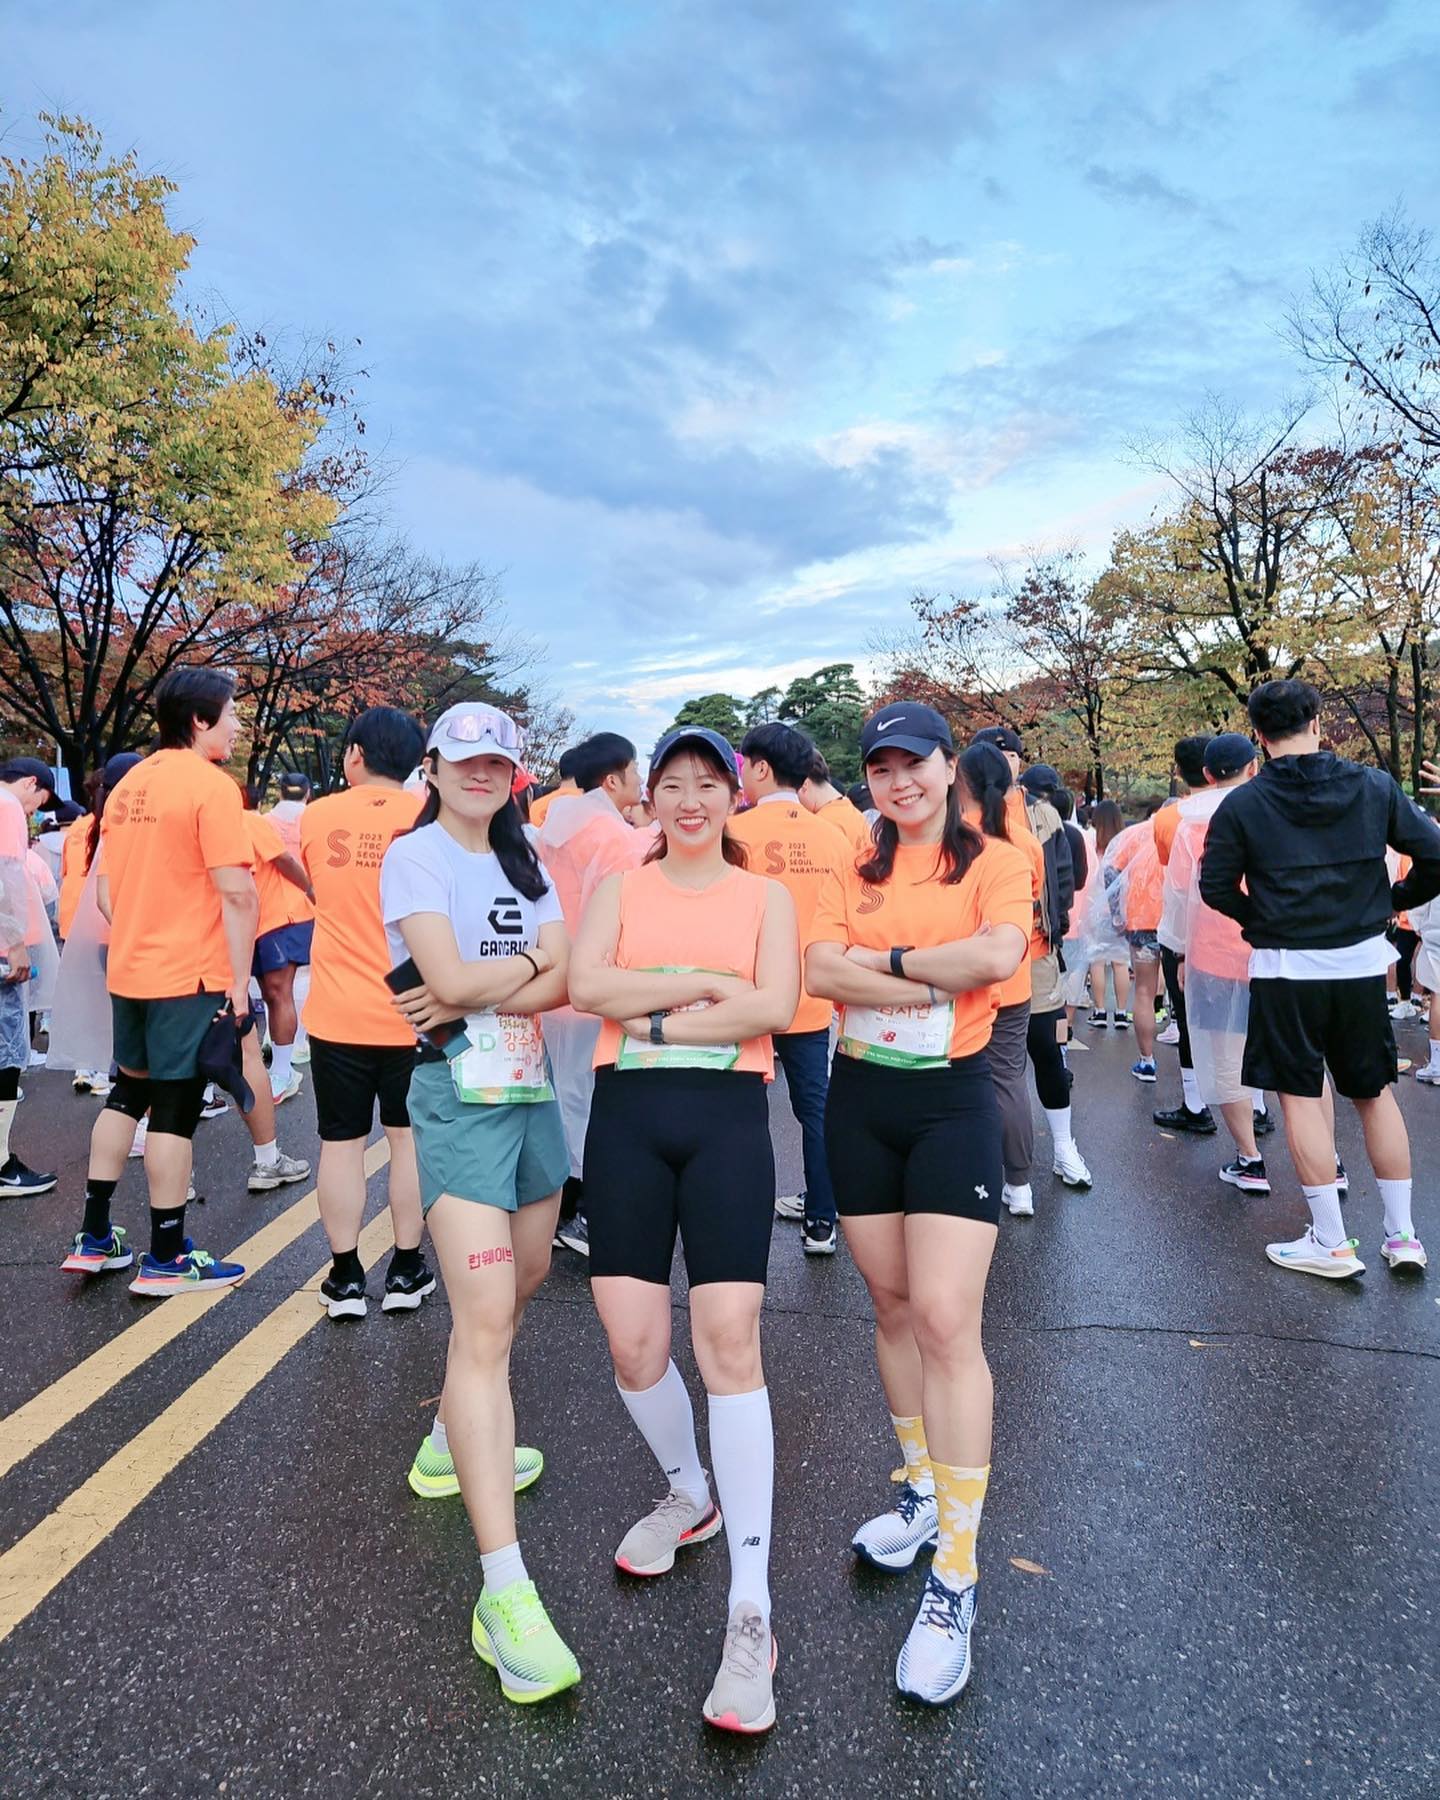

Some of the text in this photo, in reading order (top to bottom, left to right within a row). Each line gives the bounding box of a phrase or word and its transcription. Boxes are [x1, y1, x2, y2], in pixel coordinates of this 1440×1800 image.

[359, 833, 383, 841] 2023
[326, 829, 351, 868] S
[357, 851, 384, 860] SEOU
[764, 841, 786, 874] S
[479, 1033, 496, 1052] D
[468, 1247, 513, 1270] 런웨이브
